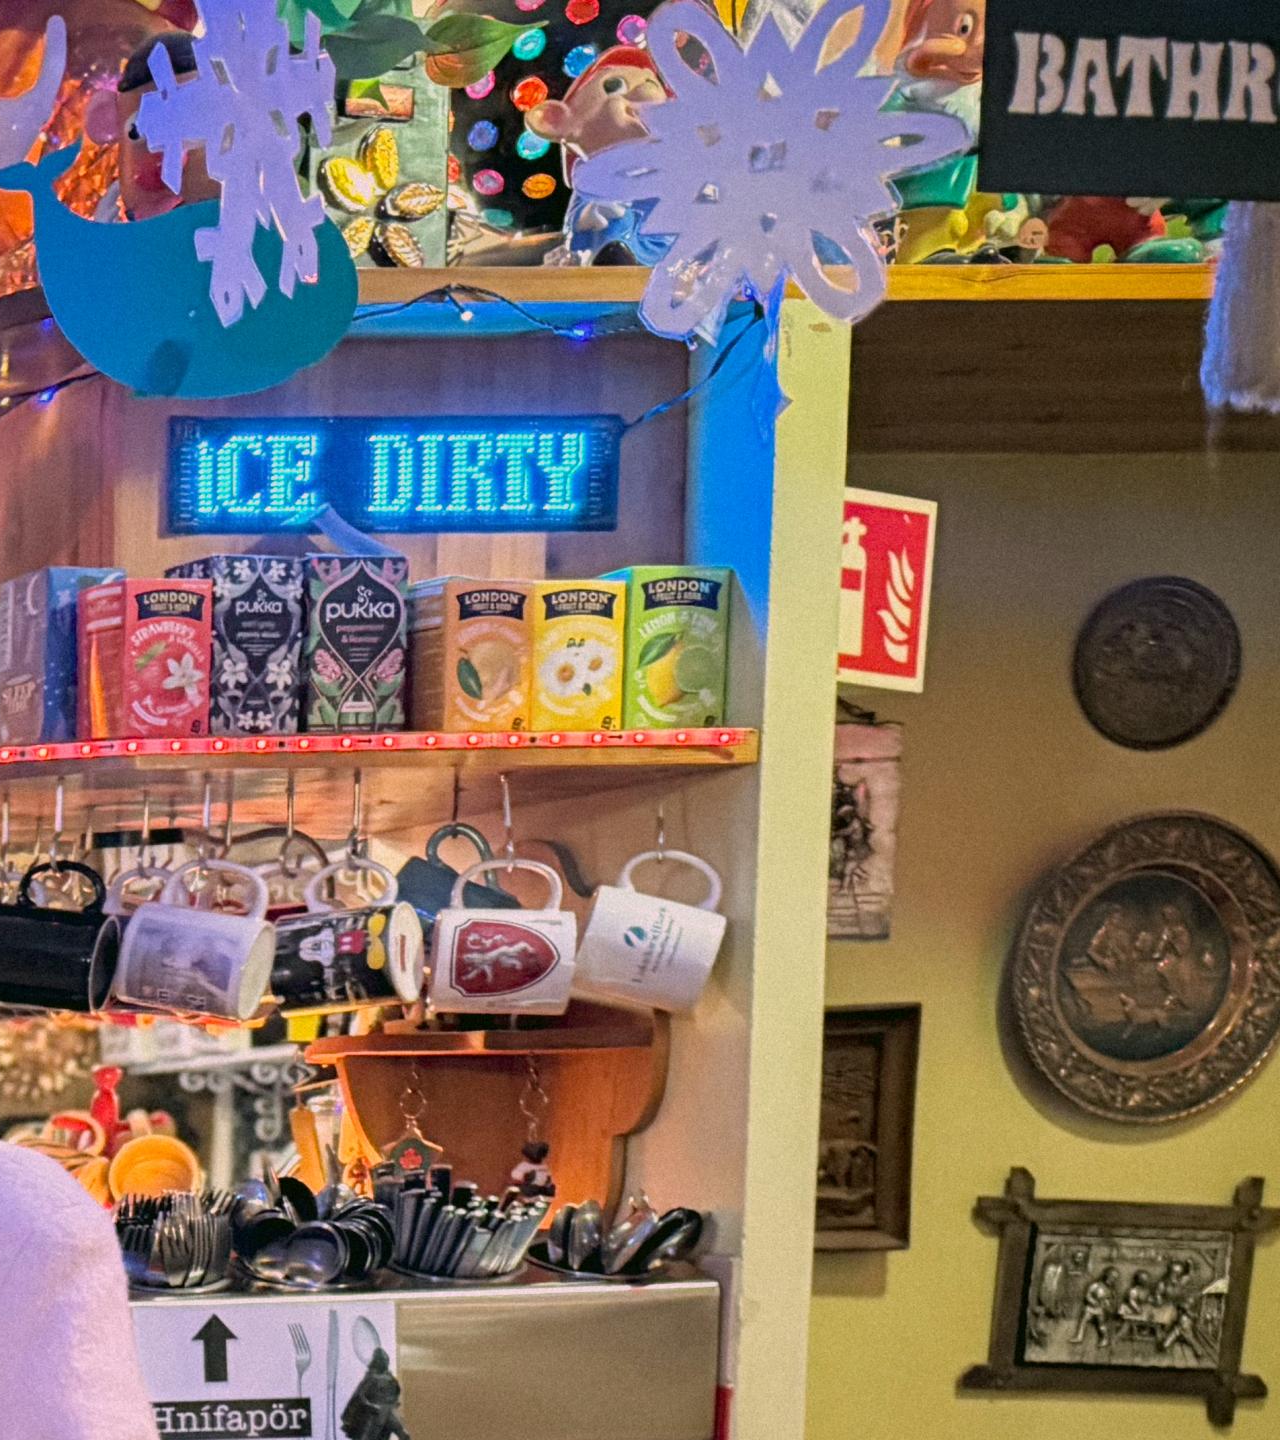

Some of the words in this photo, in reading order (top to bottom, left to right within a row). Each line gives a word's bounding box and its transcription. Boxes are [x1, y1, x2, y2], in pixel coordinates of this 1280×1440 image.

[1007, 31, 1280, 124] BATHR
[367, 432, 585, 512] DIRTY
[648, 580, 709, 593] LONDON
[143, 591, 198, 605] LONDON
[464, 591, 519, 604] LONDON
[551, 591, 608, 604] LONDON
[235, 601, 282, 615] pukka
[326, 601, 395, 622] pukka
[153, 1403, 308, 1437] Hnífapör
